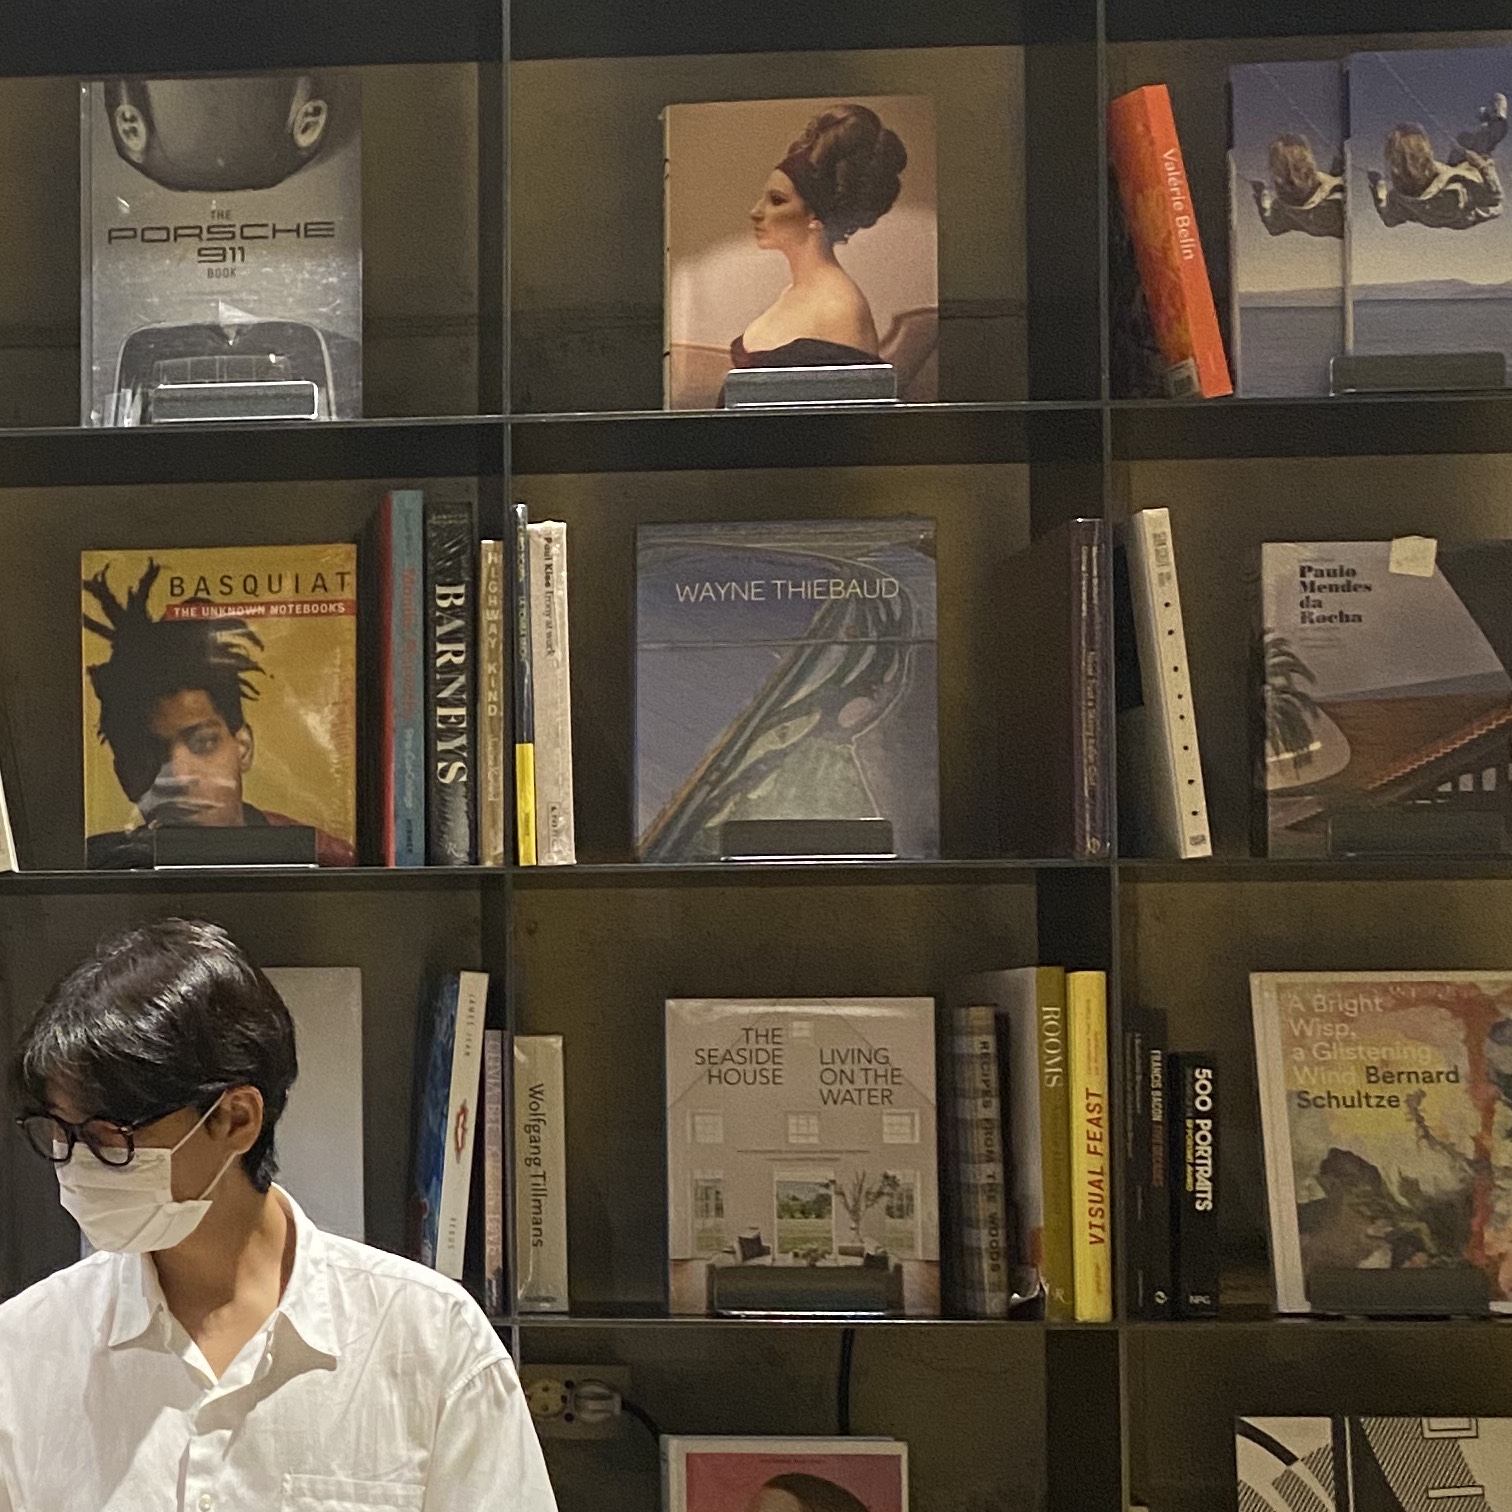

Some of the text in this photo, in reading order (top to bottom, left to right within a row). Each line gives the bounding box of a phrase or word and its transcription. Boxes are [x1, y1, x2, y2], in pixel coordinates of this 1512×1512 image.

[211, 209, 232, 219] THE
[108, 221, 335, 244] PORSCHE
[1176, 215, 1196, 260] Belin
[197, 246, 245, 263] 911
[207, 268, 237, 278] BOOK
[543, 537, 553, 561] Paul
[544, 563, 554, 588] Klee
[1299, 565, 1357, 578] Paulo
[170, 572, 350, 598] BASQUIAT
[676, 578, 900, 603] WAYNE THIEBAUD
[1299, 580, 1373, 593] Mendes
[174, 602, 346, 617] THE UNKNOWN NOTEBOOKS
[1299, 596, 1323, 609] da
[1299, 611, 1363, 625] Rocha
[486, 551, 500, 717] HIGHWAY KIND
[545, 632, 555, 657] work
[436, 583, 468, 785] BARNEYS
[1289, 994, 1384, 1018] A Bright
[741, 1028, 784, 1045] THE
[1041, 1005, 1064, 1088] ROOMS
[694, 1048, 784, 1066] SEASIDE
[820, 1047, 889, 1065] LIVING
[1292, 1042, 1432, 1064] a Glistening
[707, 1068, 784, 1085] HOUSE
[819, 1067, 903, 1085] ON THE
[1151, 1049, 1163, 1122] FRANCIS BACON
[1292, 1064, 1460, 1085] Wind Bernard
[819, 1088, 893, 1105] WATER
[1297, 1090, 1401, 1110] Schultze
[1194, 1067, 1213, 1211] 500 PORTRAITS
[523, 1083, 547, 1247] Wolfgang Tillmans
[979, 1040, 1001, 1273] RECIPES FROM THE WOODS
[1086, 1087, 1106, 1246] VISUAL FEAST
